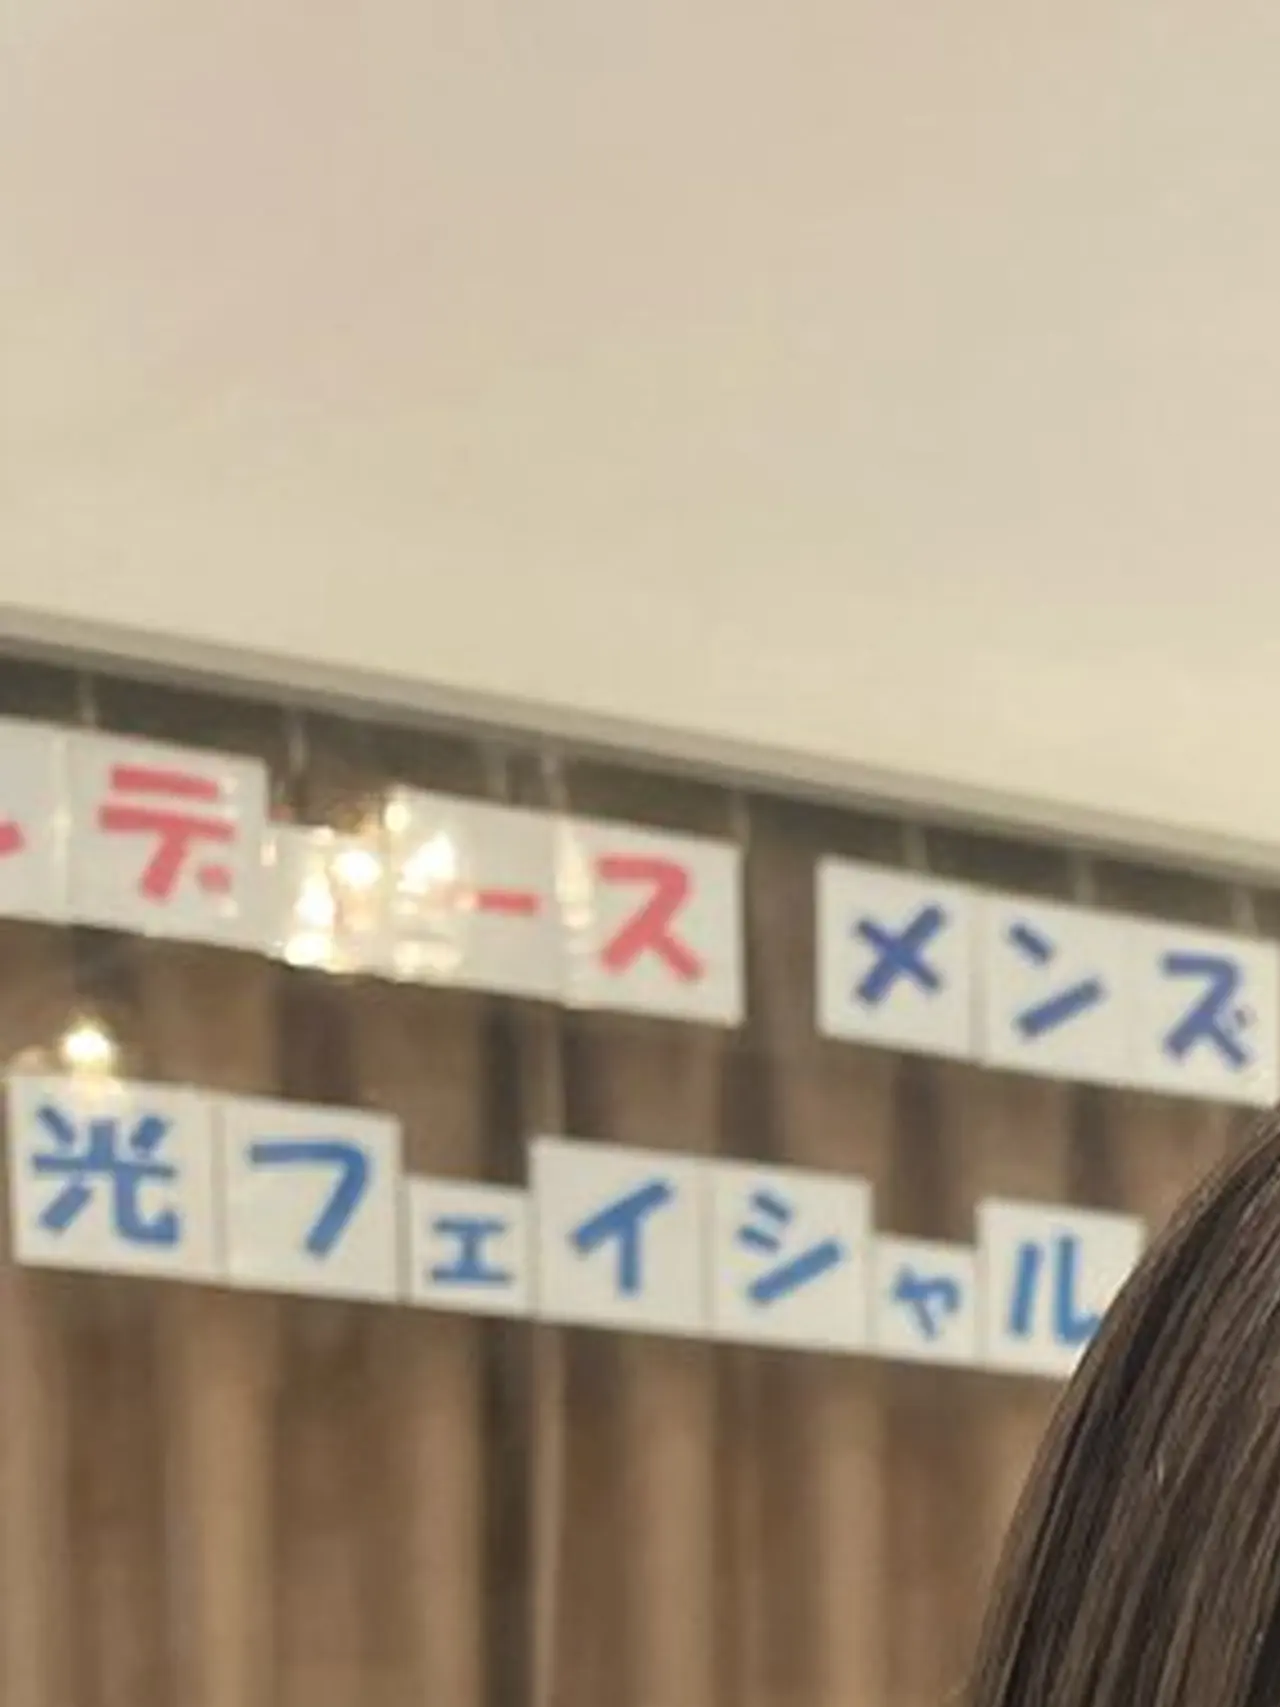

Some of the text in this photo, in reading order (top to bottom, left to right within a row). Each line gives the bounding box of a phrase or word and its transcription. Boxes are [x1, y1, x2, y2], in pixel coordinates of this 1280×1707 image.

[854, 901, 1256, 1070] メンズ
[28, 1100, 1102, 1352] 光フェイシャル
